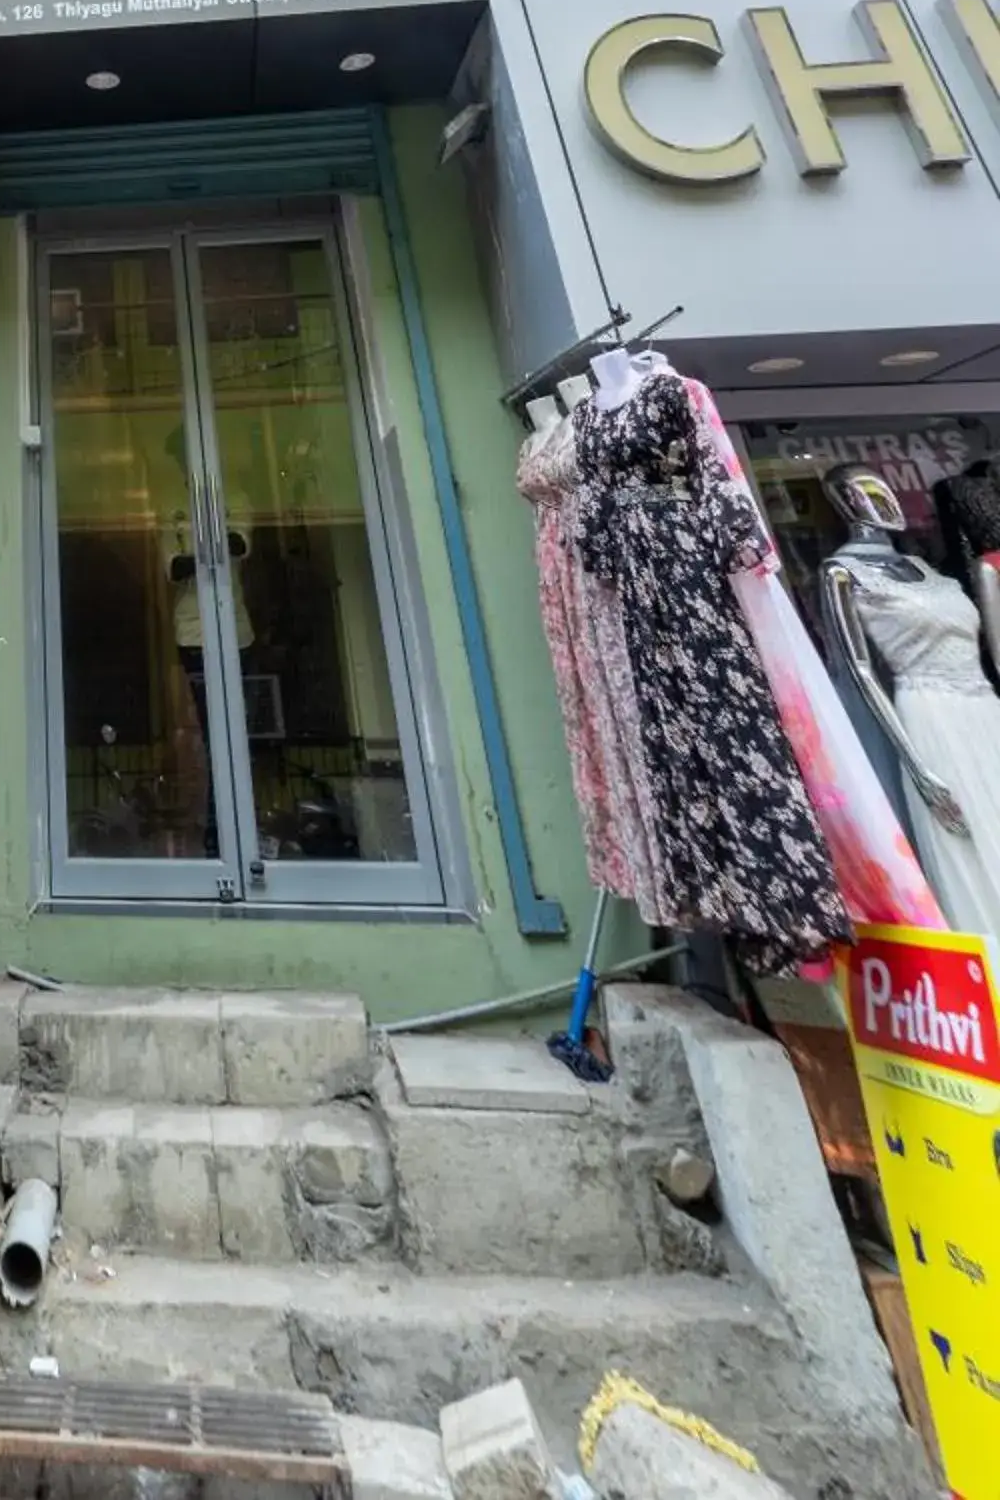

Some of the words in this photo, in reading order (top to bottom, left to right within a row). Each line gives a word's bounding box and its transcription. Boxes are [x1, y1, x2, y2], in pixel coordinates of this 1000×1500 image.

[13, 3, 43, 20] 126
[53, 0, 122, 20] Thiyagu
[861, 957, 987, 1063] Prithvi
